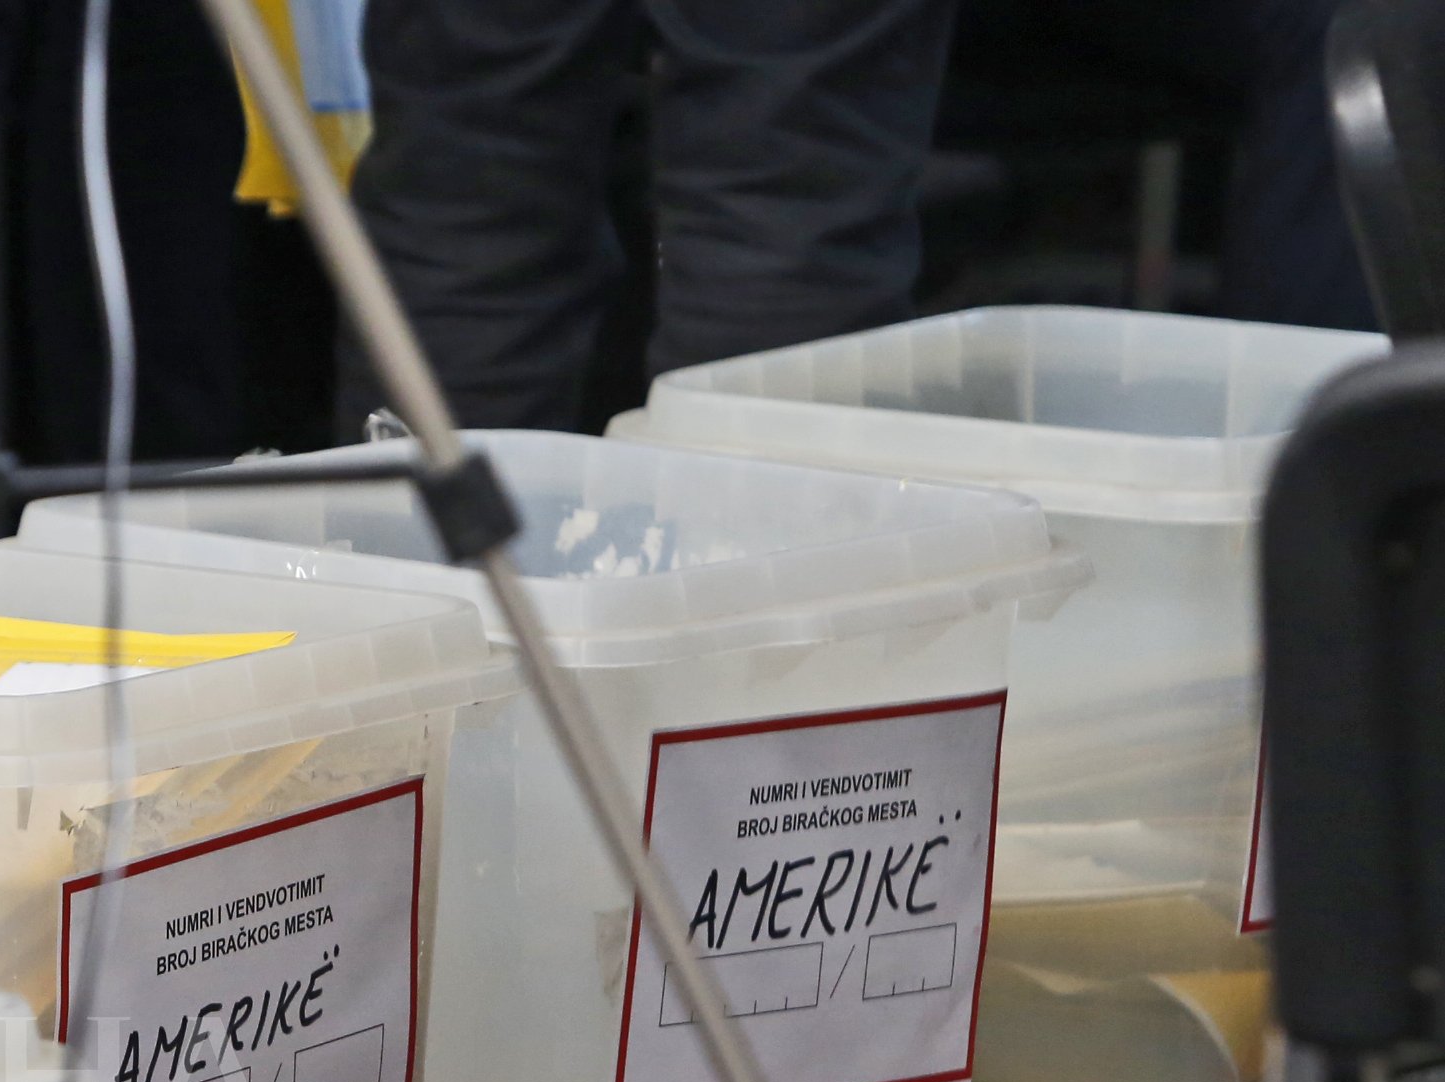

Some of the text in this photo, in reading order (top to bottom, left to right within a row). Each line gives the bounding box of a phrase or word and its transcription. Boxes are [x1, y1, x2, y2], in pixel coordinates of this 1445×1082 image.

[737, 800, 918, 839] BROJ BIRAČKOG MESTA
[749, 768, 913, 806] NUMRI I VENDVOTIMIT
[165, 874, 326, 940] NUMRI I VENDVOTIMIT
[686, 809, 962, 950] AMERIKË
[156, 905, 334, 976] BROJ BIRAČKOG MESTA
